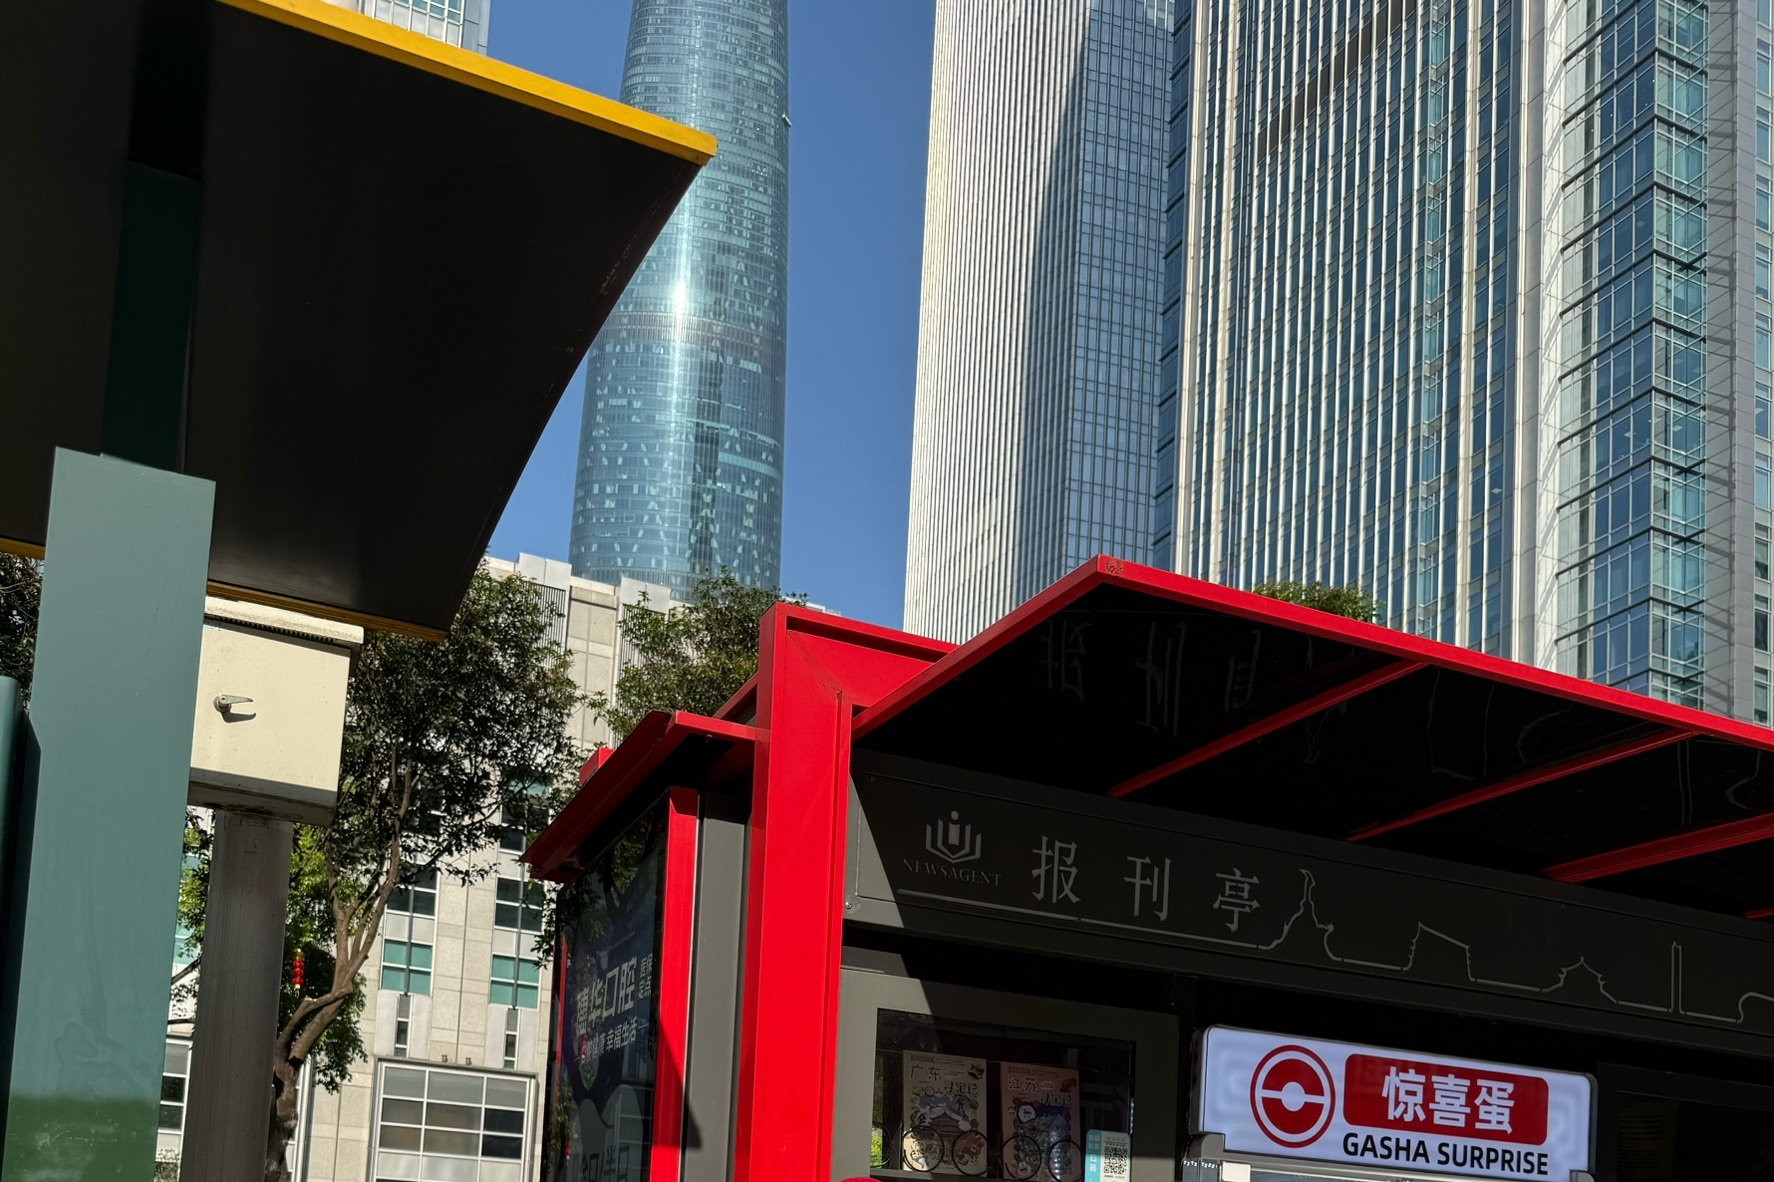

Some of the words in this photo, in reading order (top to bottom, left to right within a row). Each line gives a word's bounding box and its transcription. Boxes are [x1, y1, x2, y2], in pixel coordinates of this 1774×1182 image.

[902, 858, 1002, 886] NEWSAGENT
[1031, 833, 1262, 934] 报刊亭
[1382, 1066, 1516, 1134] 惊喜蛋
[1342, 1132, 1430, 1164] GASHA
[1437, 1141, 1549, 1176] SURPRISE
